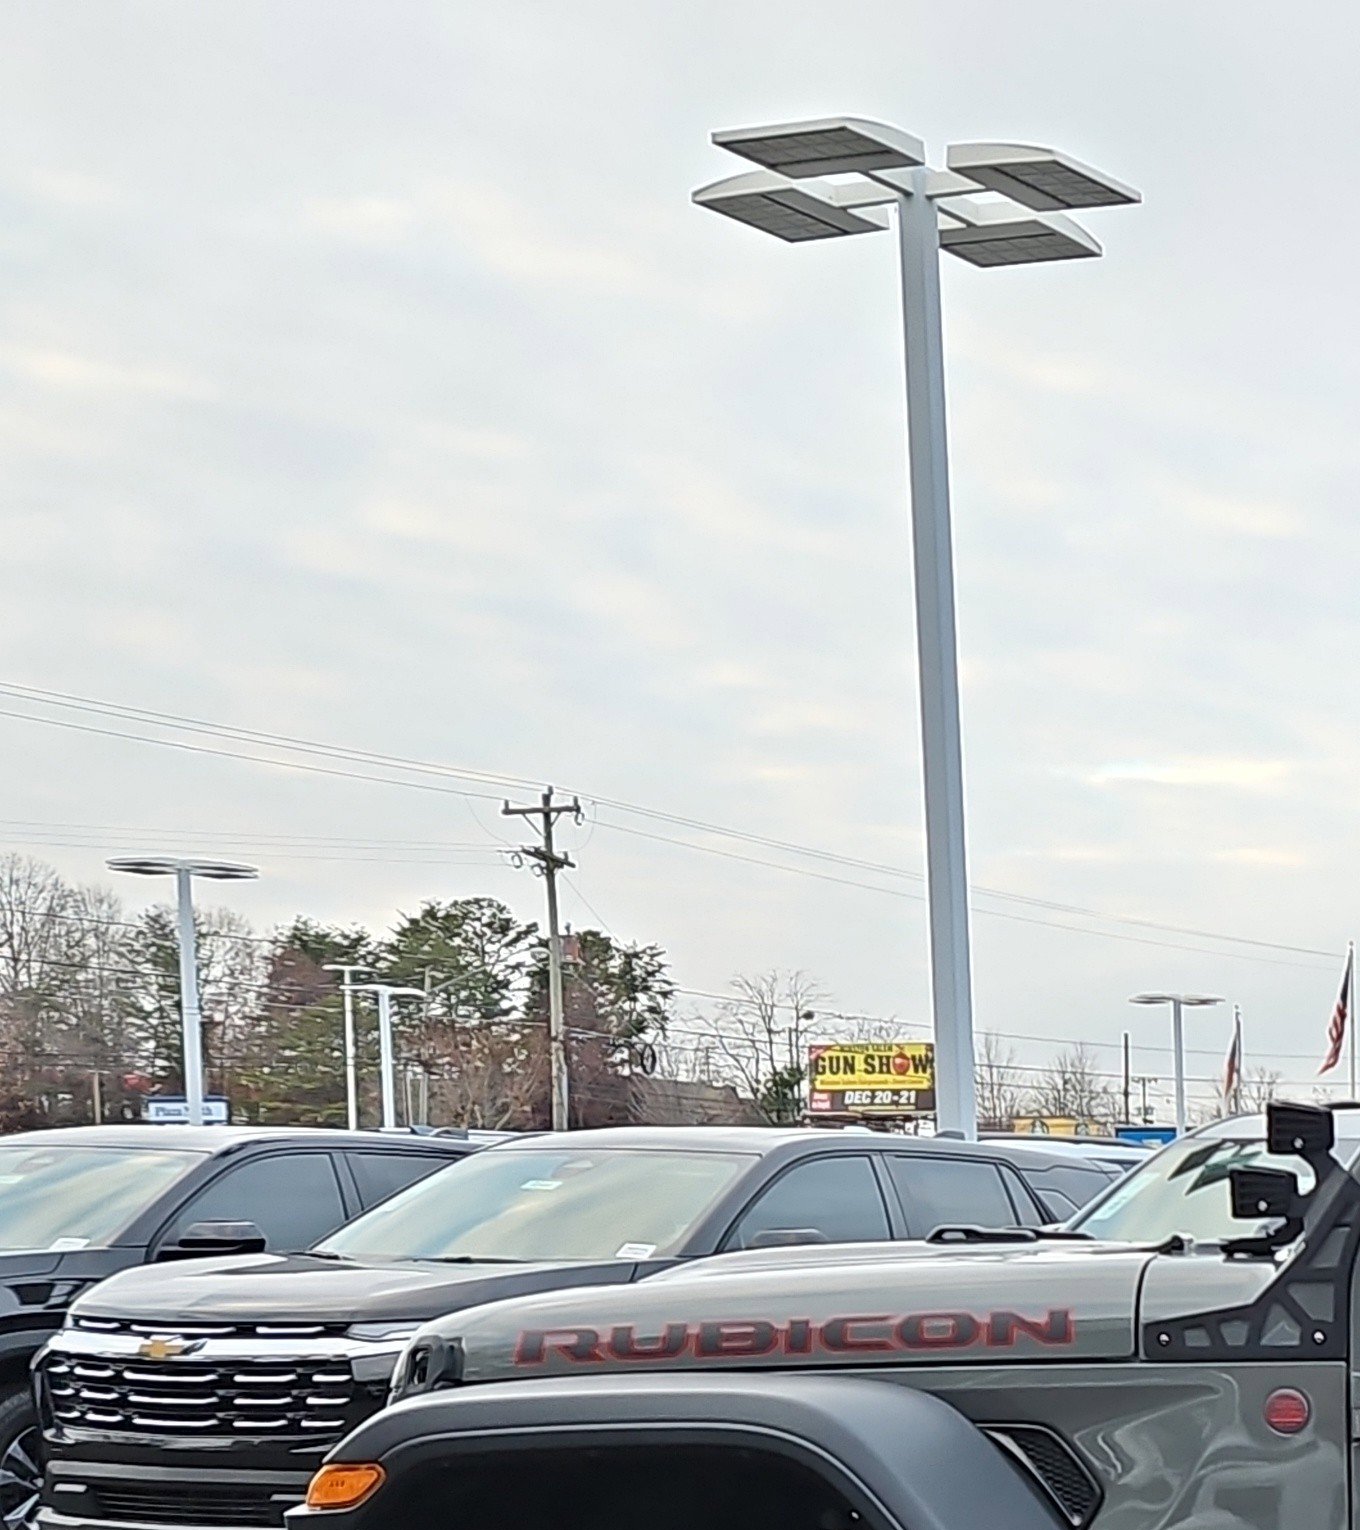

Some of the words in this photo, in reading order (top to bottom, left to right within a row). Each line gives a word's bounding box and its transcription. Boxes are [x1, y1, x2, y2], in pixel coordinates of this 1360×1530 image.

[815, 1054, 856, 1076] GUN
[863, 1053, 930, 1076] SHOW
[844, 1090, 871, 1105] DEC
[873, 1090, 917, 1104] 20-21
[514, 1308, 1077, 1365] RUBICON
